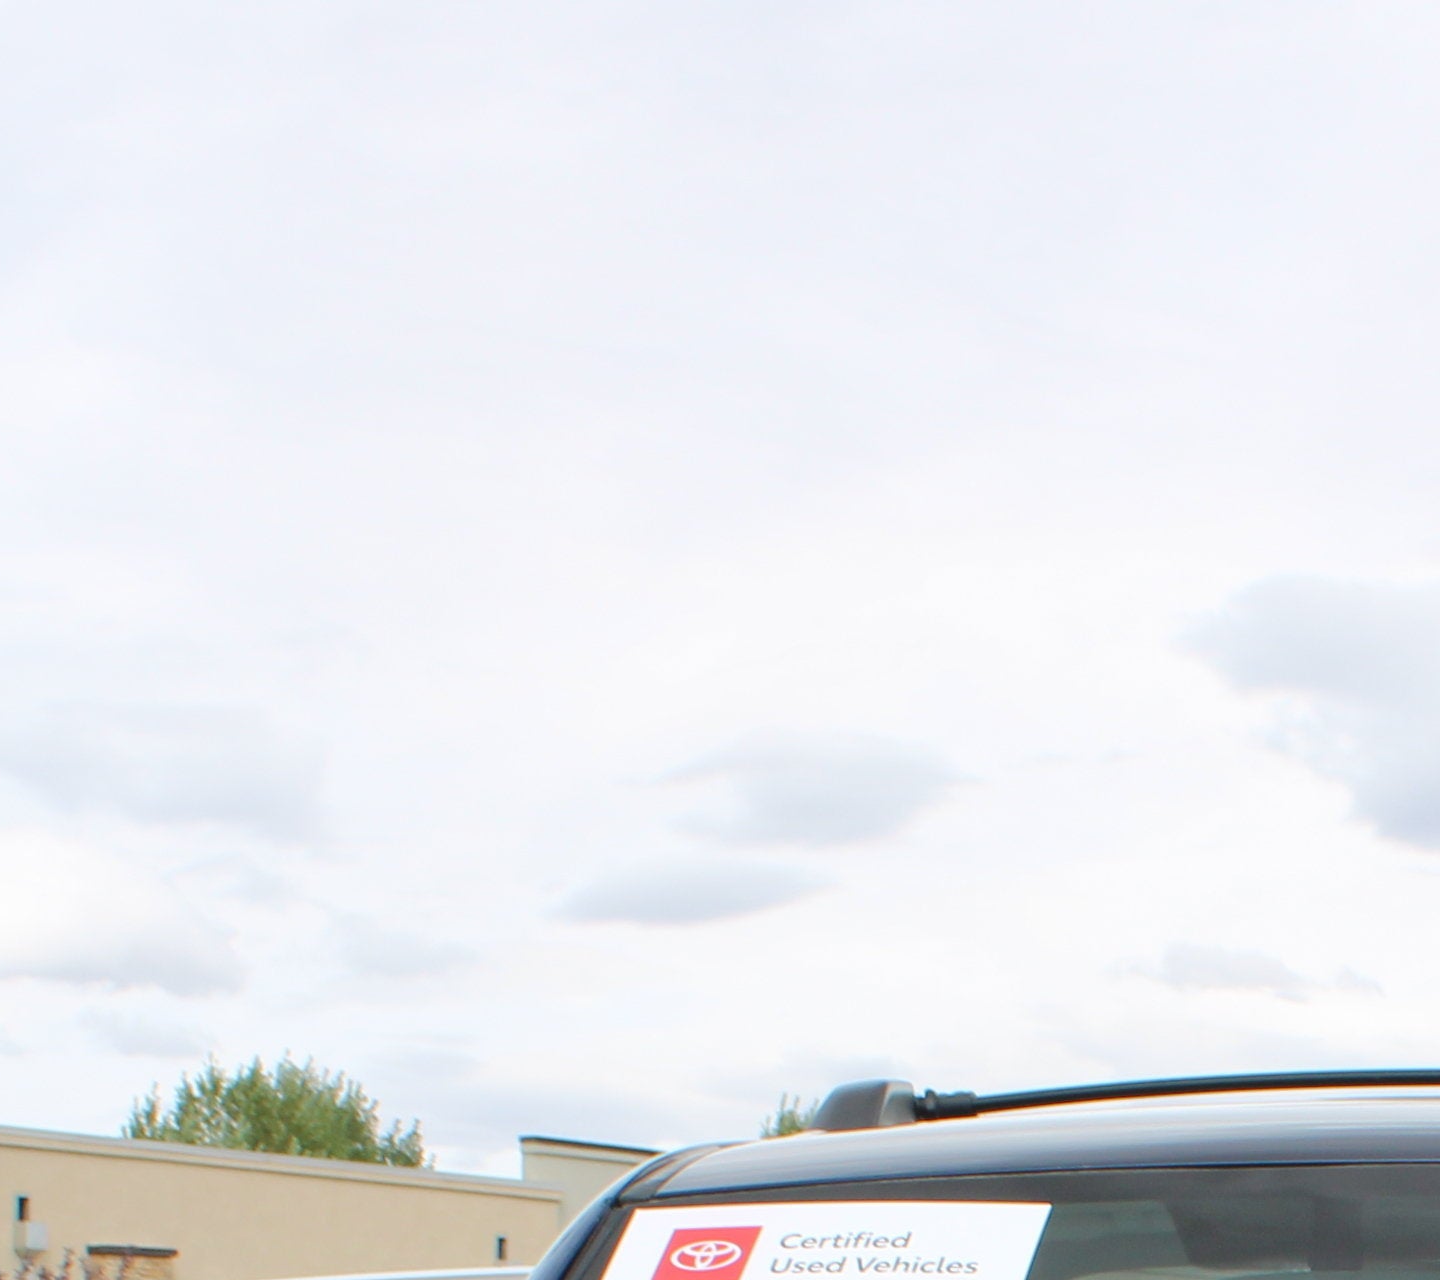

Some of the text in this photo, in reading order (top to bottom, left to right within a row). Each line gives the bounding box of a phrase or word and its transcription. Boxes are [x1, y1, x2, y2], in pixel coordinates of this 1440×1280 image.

[779, 1231, 913, 1251] Certified
[768, 1256, 980, 1275] Used Vehicles
